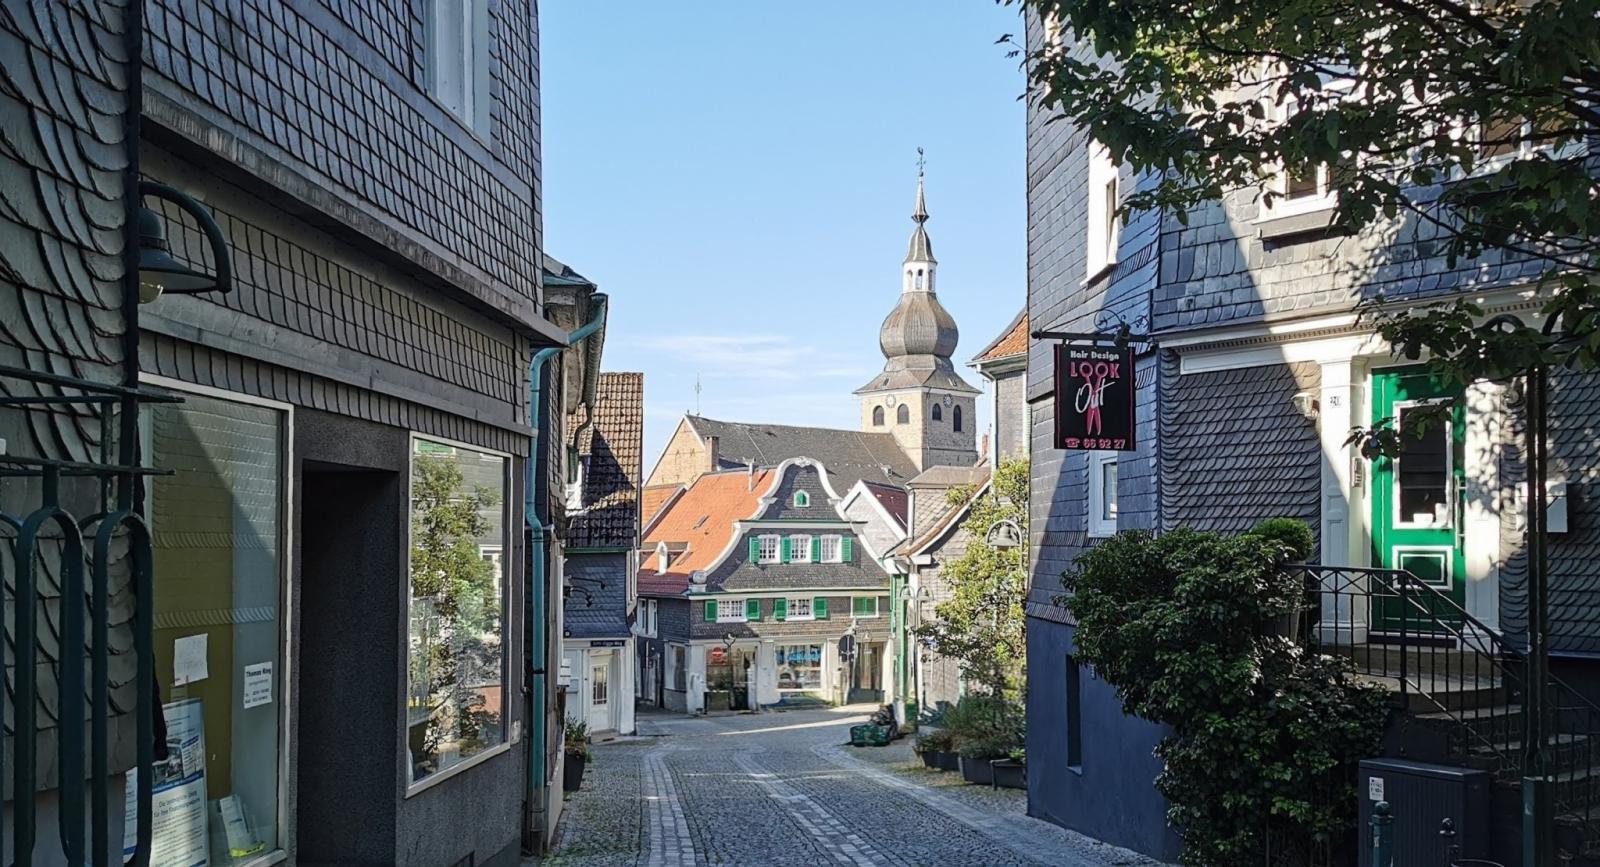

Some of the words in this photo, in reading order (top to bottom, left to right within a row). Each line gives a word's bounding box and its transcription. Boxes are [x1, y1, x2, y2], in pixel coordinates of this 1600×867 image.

[1070, 350, 1088, 358] Hair
[1091, 351, 1119, 361] Design
[1070, 361, 1120, 379] LOOK
[1075, 378, 1115, 413] Out
[1083, 438, 1097, 449] 66
[1099, 438, 1111, 449] 92
[1113, 438, 1126, 449] 27
